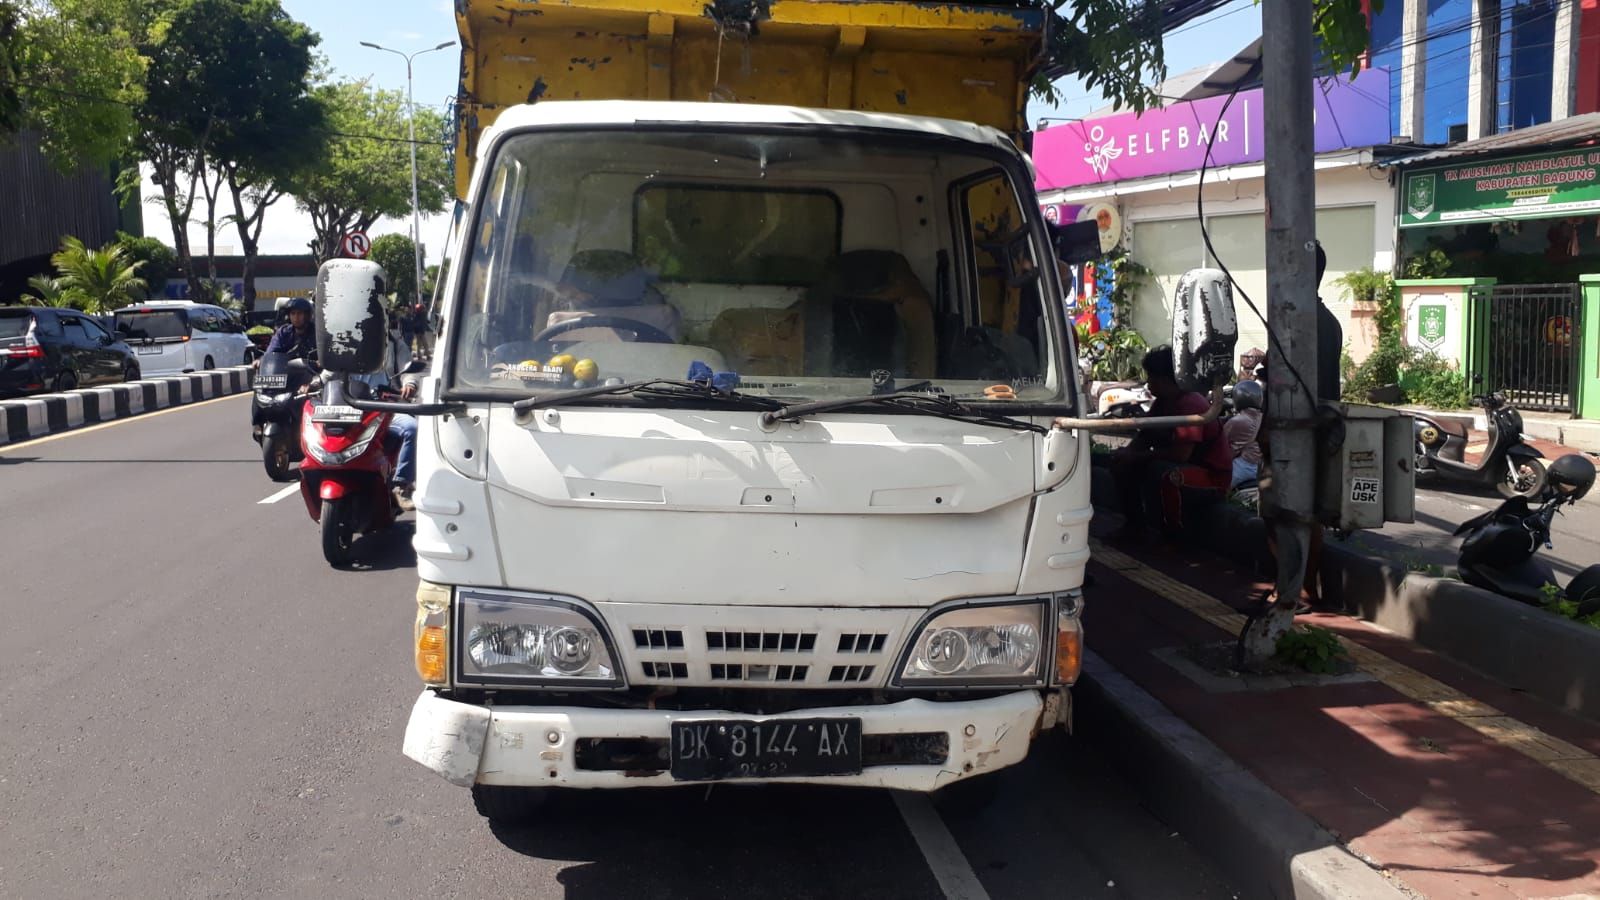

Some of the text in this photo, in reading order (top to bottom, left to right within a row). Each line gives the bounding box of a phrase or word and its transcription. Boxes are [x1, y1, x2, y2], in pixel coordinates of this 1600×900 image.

[1128, 120, 1229, 156] ELFBAR
[1445, 170, 1458, 181] TK
[1459, 163, 1514, 180] MUSLIMAT
[1516, 156, 1585, 172] NAHDLATUL
[1476, 169, 1597, 192] KABUPATEN BADUNG
[1352, 492, 1376, 502] USK
[1354, 482, 1378, 492] APE
[680, 723, 849, 759] DK 8144 AX
